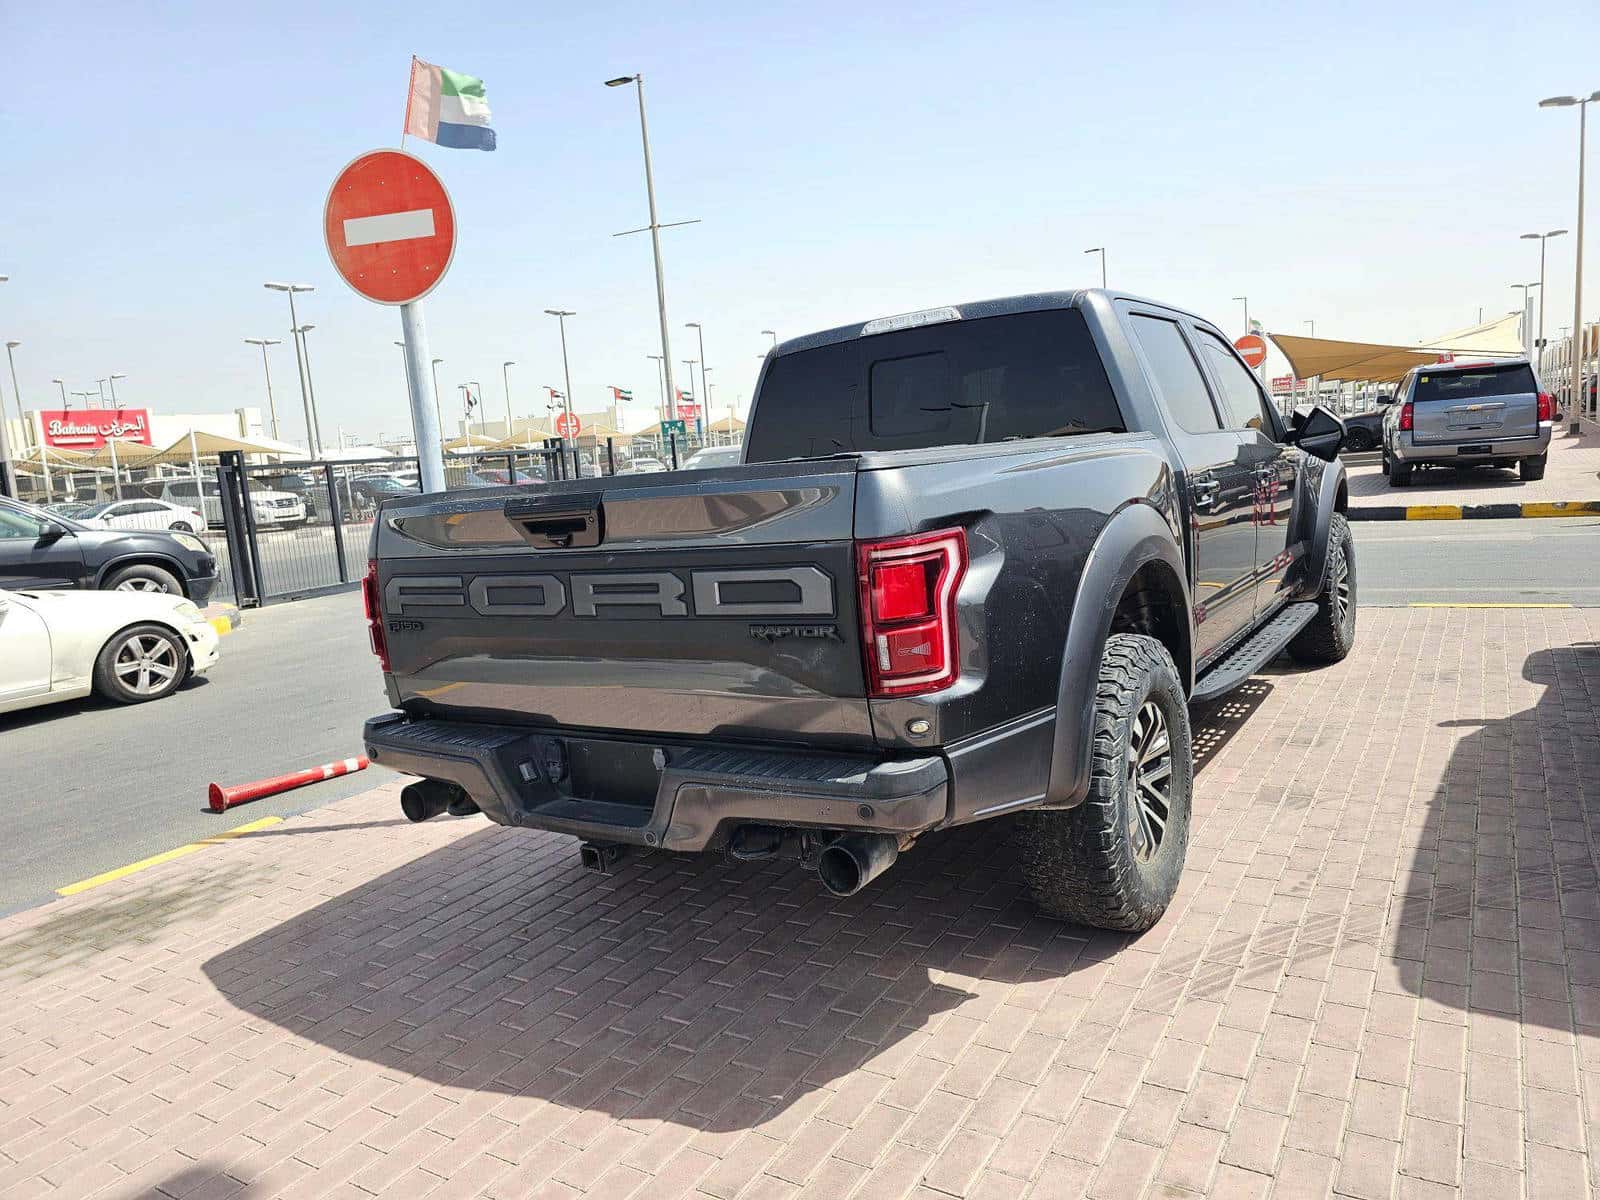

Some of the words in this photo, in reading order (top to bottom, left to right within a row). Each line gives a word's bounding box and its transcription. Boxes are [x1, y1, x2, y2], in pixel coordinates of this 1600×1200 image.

[49, 420, 97, 436] Bahrain
[384, 567, 835, 617] FORD
[749, 624, 840, 641] RAPTOR
